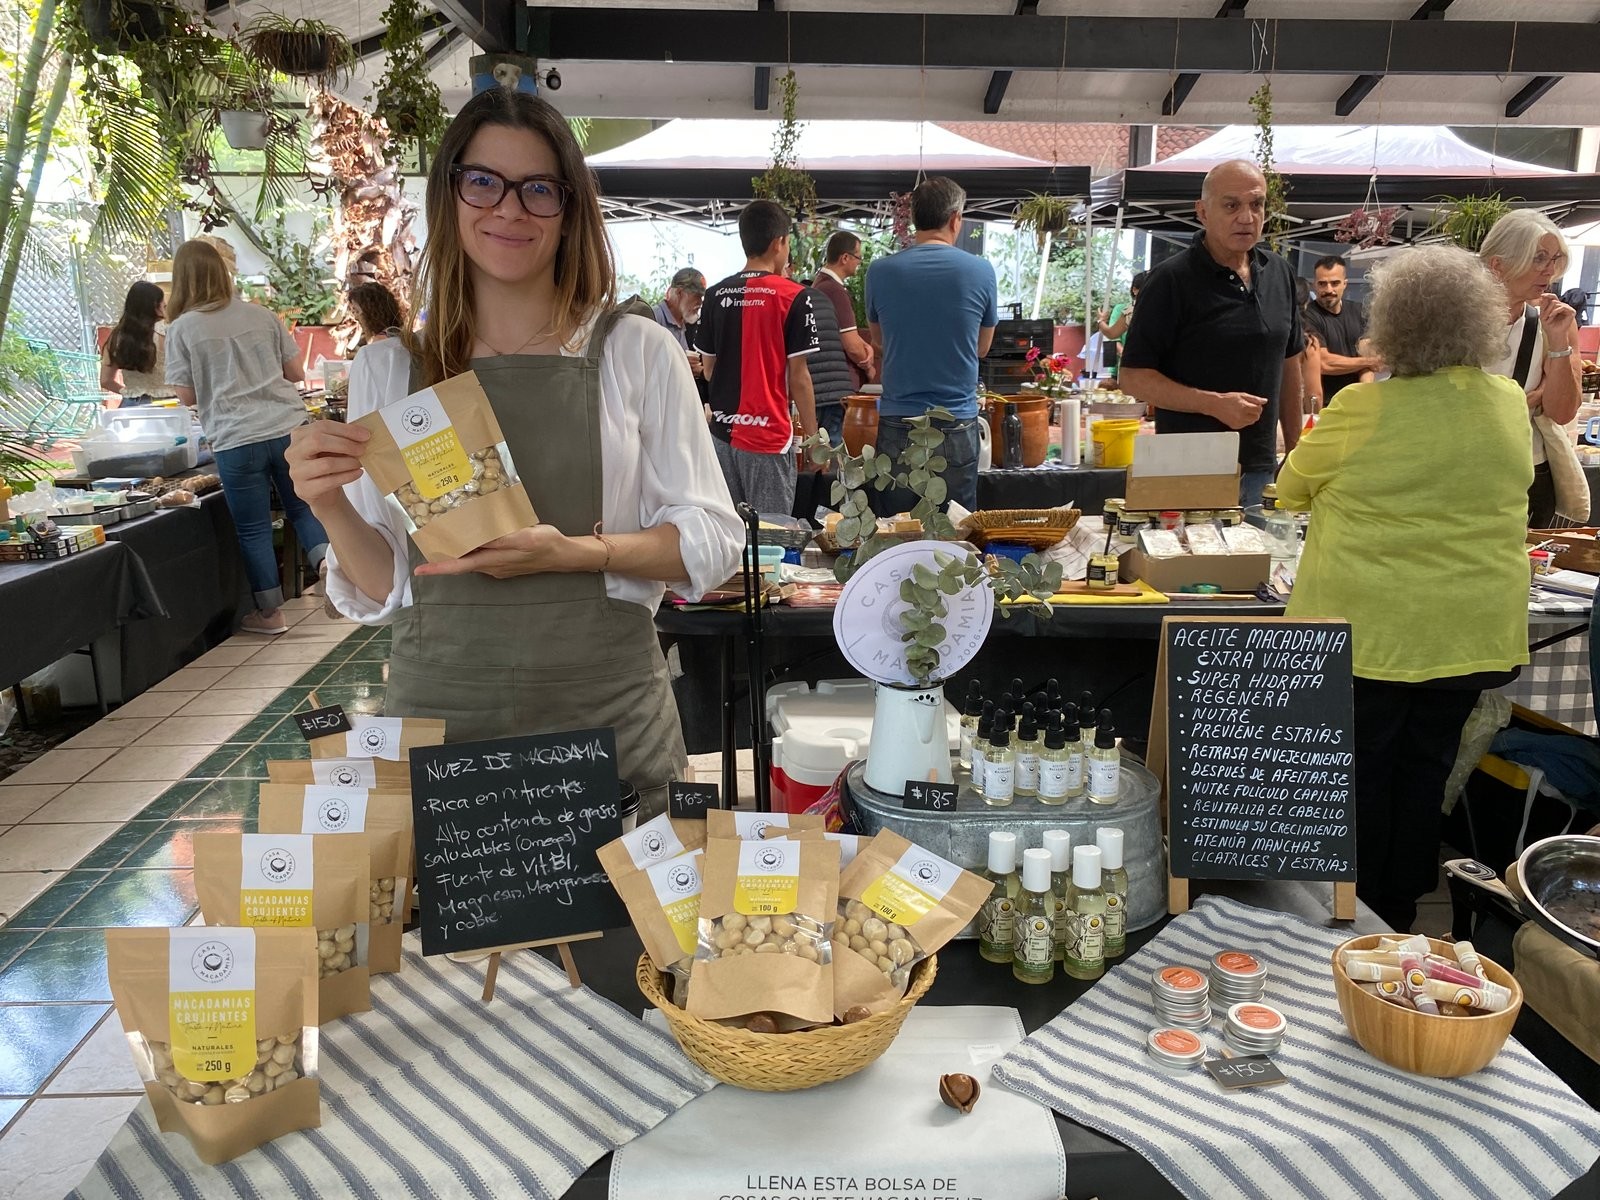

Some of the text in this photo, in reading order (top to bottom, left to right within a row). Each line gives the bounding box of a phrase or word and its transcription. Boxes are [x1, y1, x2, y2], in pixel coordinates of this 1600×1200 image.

[405, 431, 453, 458] MACADAMIAS
[440, 476, 453, 487] 250
[873, 591, 975, 670] MADAMIA
[1174, 628, 1347, 653] ACEITE MACADAMIA
[1197, 651, 1327, 672] EXTRA VIRGEN
[1187, 670, 1324, 690] SUPER HIDRATA
[1190, 688, 1290, 707] REGENERA
[1192, 707, 1250, 723] NUTRE
[1191, 723, 1264, 740] PREVIENE
[426, 738, 609, 783] NUEZ DE MACADAMIA
[1189, 743, 1353, 766] RETRASA ENVEJECIMIENTO
[1250, 768, 1265, 781] DE
[1271, 768, 1350, 786] AFEITARSE
[1191, 782, 1234, 796] NUTRE
[1293, 788, 1349, 803] CAPILAR
[426, 798, 469, 816] Rica
[476, 792, 498, 806] en
[1193, 799, 1345, 819] REVITALIZA EL CABELLO
[436, 823, 470, 846] Alto
[477, 811, 551, 838] contenido
[558, 808, 574, 823] de
[1192, 817, 1348, 837] ESTIMULA SU CRECIMIENTO
[1251, 838, 1322, 853] MANCHAS
[1192, 851, 1270, 868] CICATRICES
[1278, 857, 1287, 872] Y
[436, 863, 494, 895] Fuente
[500, 859, 518, 877] de
[244, 896, 309, 905] MACADAMIAS
[880, 905, 892, 915] 100
[246, 907, 306, 917] CRUJIENTES
[198, 946, 216, 958] CASA
[200, 956, 230, 980] MACADAMIA
[174, 998, 251, 1010] MACADAMIAS
[177, 1011, 248, 1023] CRUJIENTES
[205, 1060, 222, 1072] 250
[225, 1062, 231, 1073] g
[747, 1175, 957, 1190] LLENA ESTA BOLSA DE
